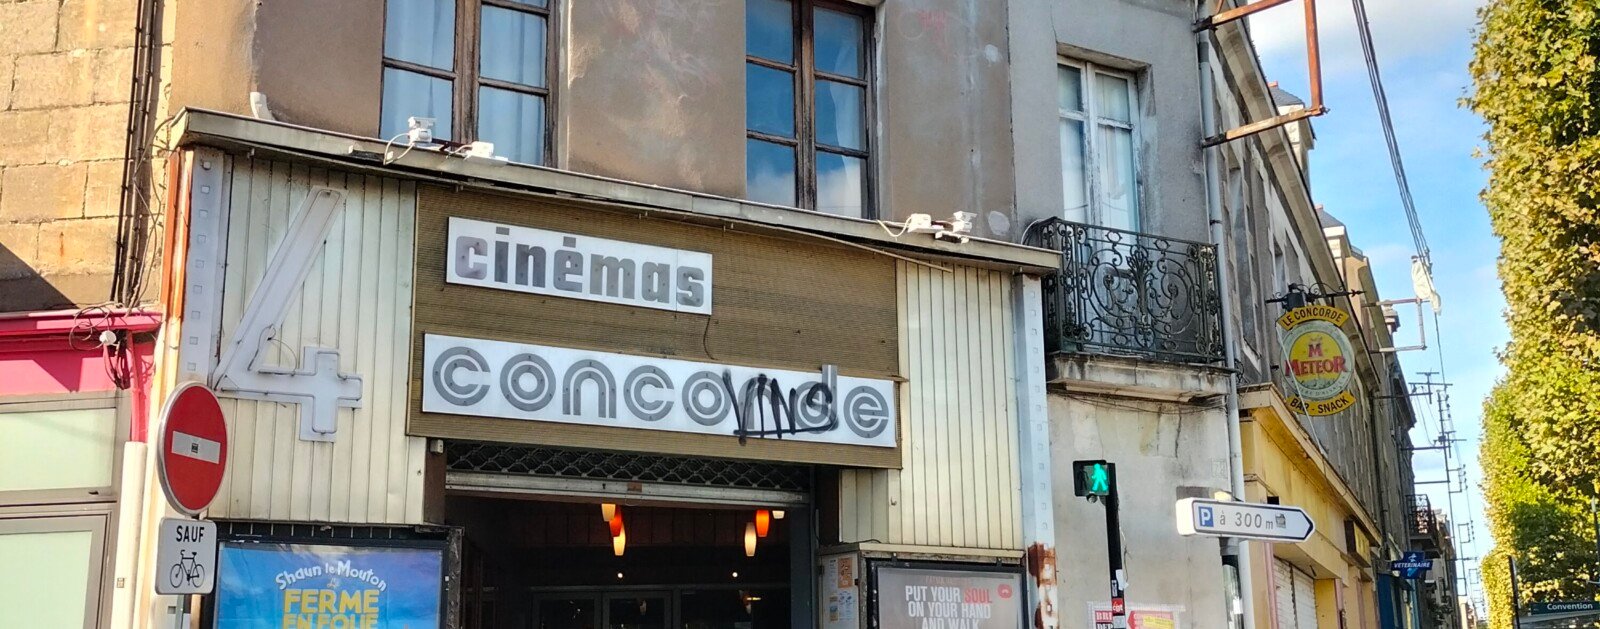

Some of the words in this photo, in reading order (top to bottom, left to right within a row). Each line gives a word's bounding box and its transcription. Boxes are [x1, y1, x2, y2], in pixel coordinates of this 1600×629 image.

[455, 226, 704, 308] cinémas
[211, 185, 363, 441] 4
[1282, 315, 1294, 326] LE
[1294, 307, 1343, 321] CONCORDE
[432, 345, 889, 439] concorde
[1290, 398, 1310, 413] BAR
[1317, 396, 1349, 414] SNACK
[1219, 509, 1226, 525] à
[1235, 511, 1262, 528] 300
[1265, 519, 1273, 530] m
[176, 525, 205, 543] SAUF
[275, 565, 322, 590] Shaun
[325, 562, 336, 574] le
[337, 559, 387, 592] Mouton
[284, 589, 380, 614] FERME
[905, 585, 928, 602] PUT
[930, 586, 961, 603] YOUR
[963, 588, 992, 604] SOUL
[908, 601, 924, 618] ON
[927, 602, 957, 618] YOUR
[961, 603, 991, 619] HAND
[283, 613, 313, 629] EN
[922, 618, 944, 629] AND
[948, 619, 980, 629] WALK
